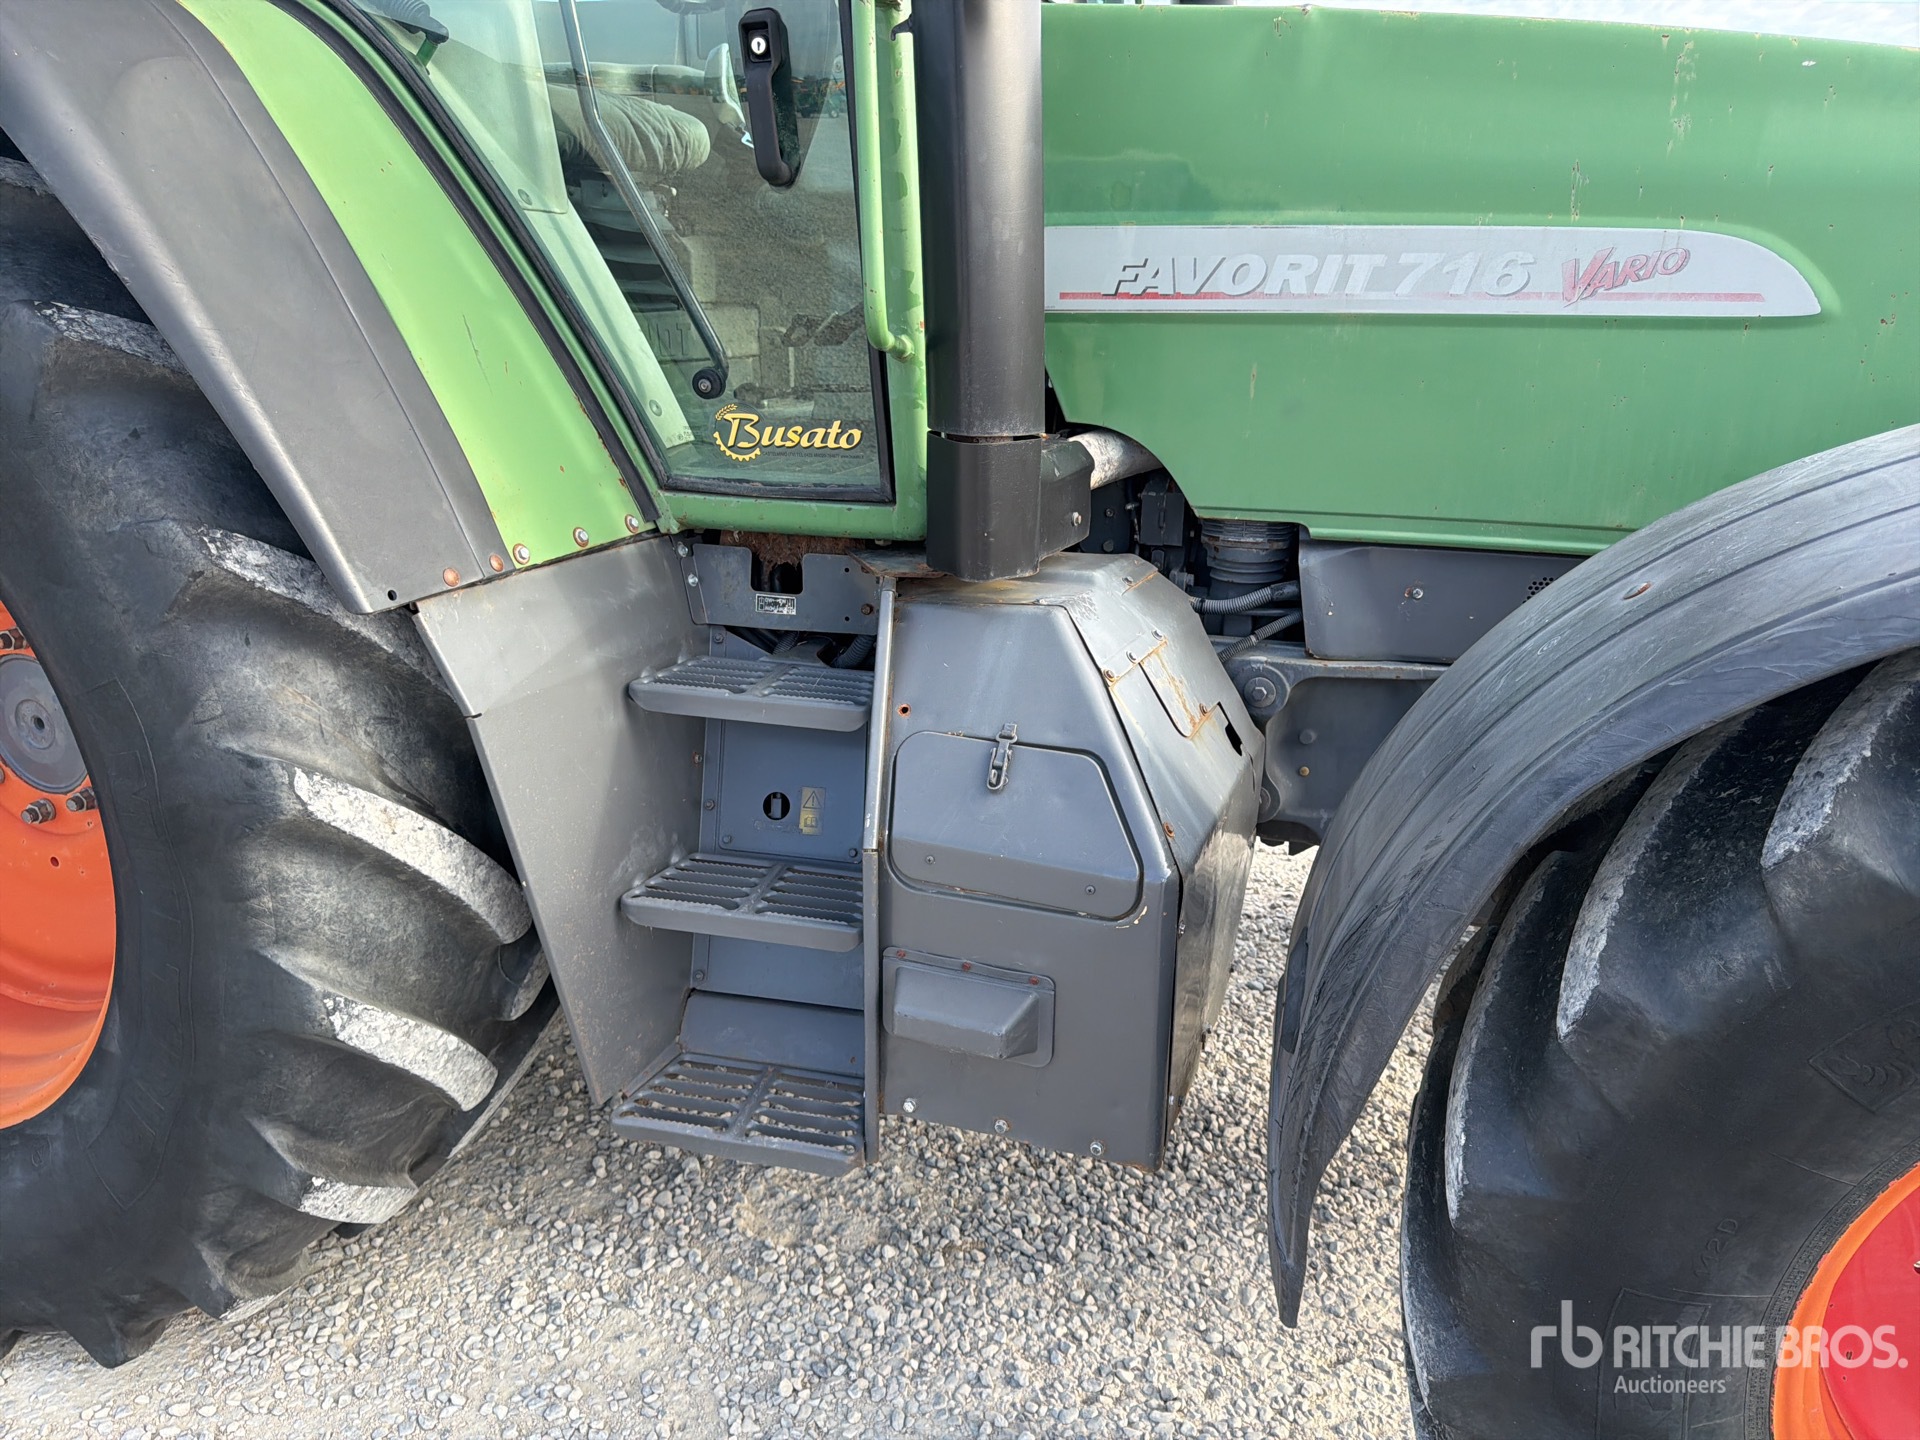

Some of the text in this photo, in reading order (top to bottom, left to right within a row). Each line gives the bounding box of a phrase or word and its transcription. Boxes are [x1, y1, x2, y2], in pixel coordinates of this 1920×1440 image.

[1101, 253, 1388, 297] FAVORIT
[1394, 250, 1536, 298] 716
[723, 412, 863, 450] Busato
